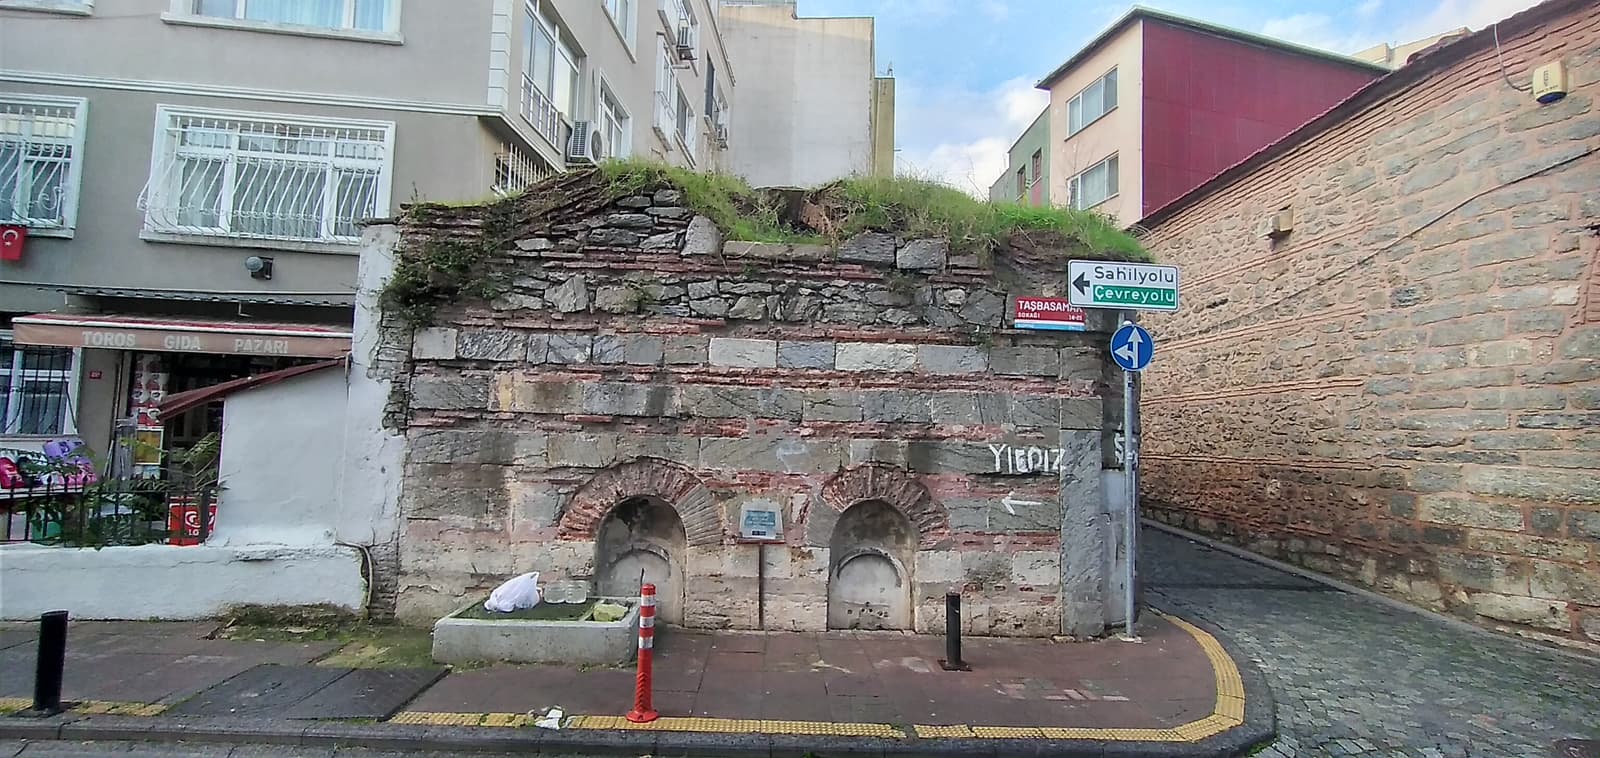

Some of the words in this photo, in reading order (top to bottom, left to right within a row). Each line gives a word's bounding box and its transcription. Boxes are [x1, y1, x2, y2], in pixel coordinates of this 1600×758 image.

[1094, 266, 1174, 284] Sahilyolu
[1094, 285, 1175, 303] Çevreyolu
[82, 331, 136, 347] TOROS
[164, 335, 201, 350] GIDA
[234, 338, 288, 354] PAZARI
